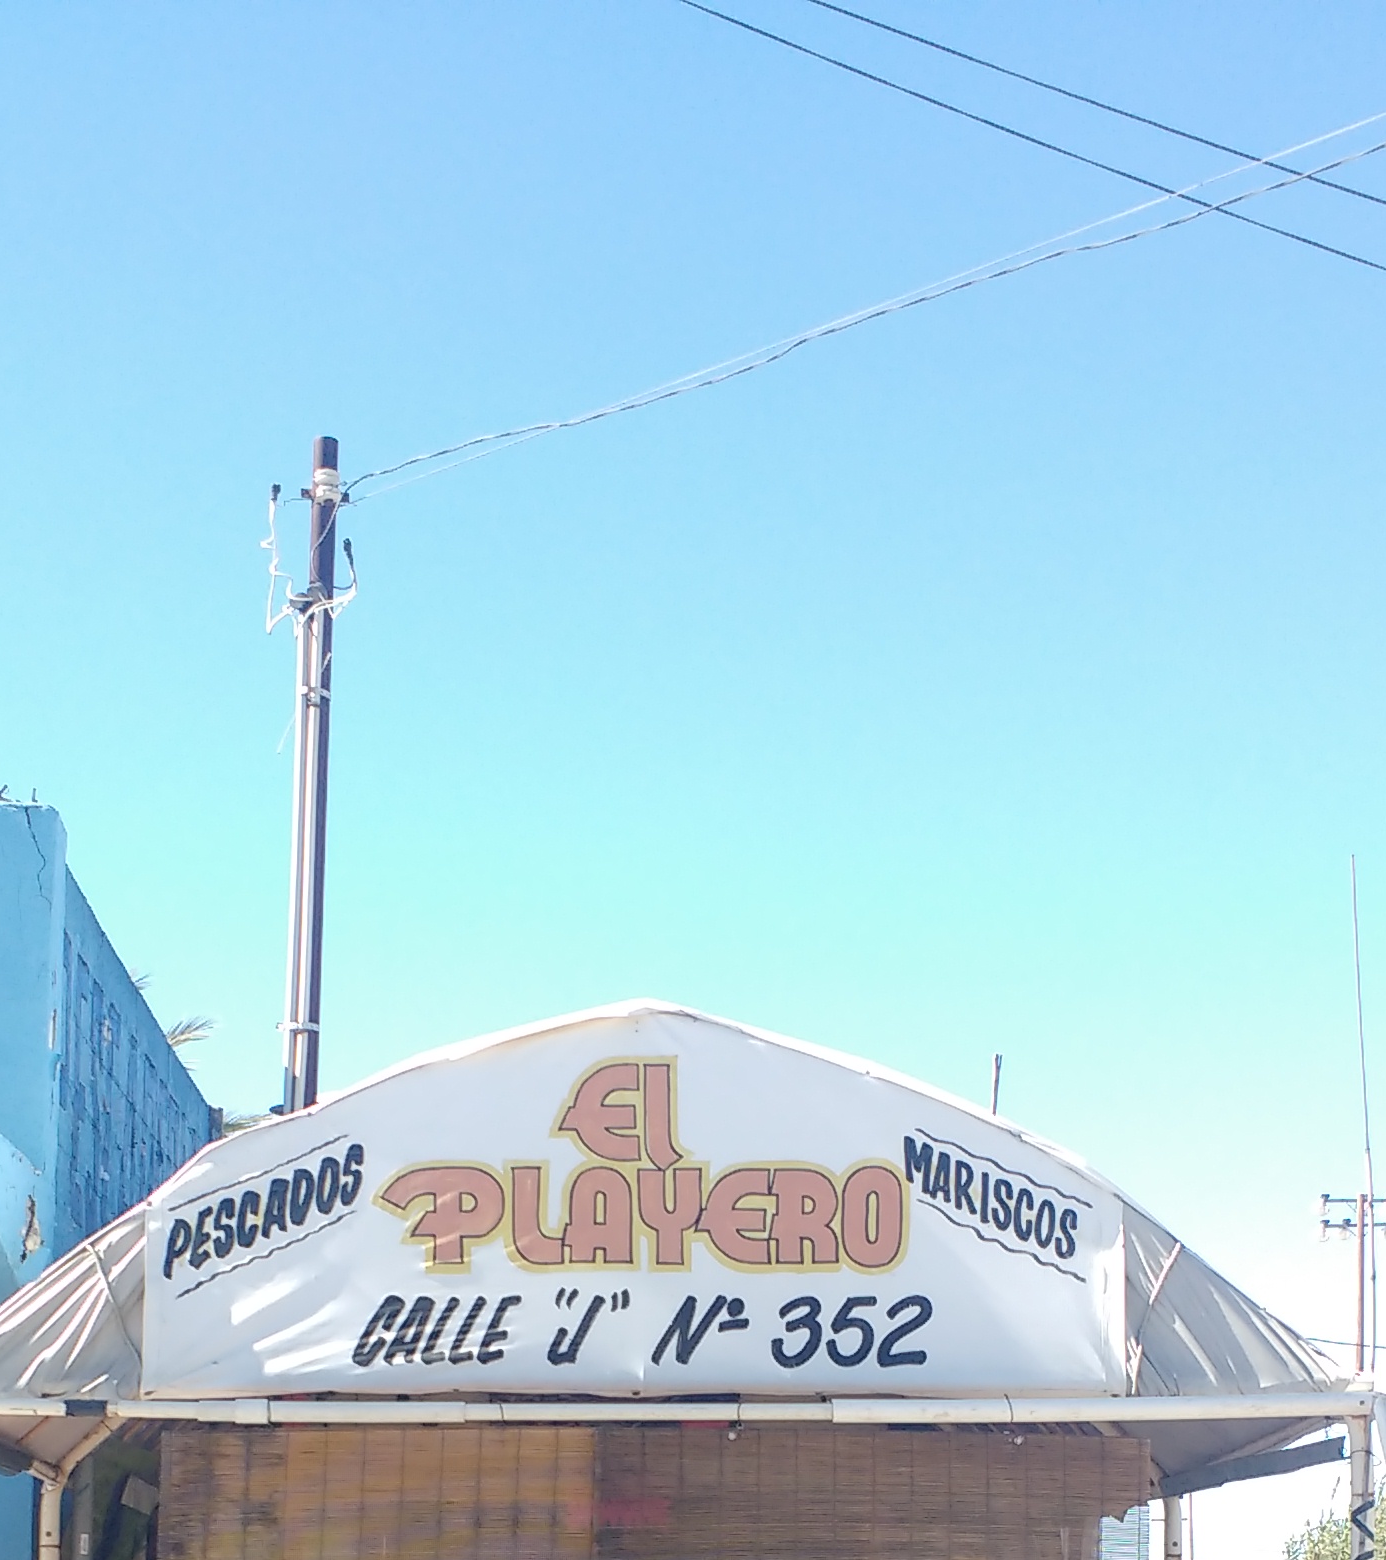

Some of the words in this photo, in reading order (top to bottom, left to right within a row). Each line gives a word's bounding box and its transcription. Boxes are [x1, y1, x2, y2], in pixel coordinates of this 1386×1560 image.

[164, 1144, 364, 1280] PESCADOS
[379, 1166, 903, 1268] PLAYERO
[903, 1136, 1077, 1259] MARISCOS
[352, 1295, 522, 1366] CALLE
[771, 1295, 932, 1368] 352
